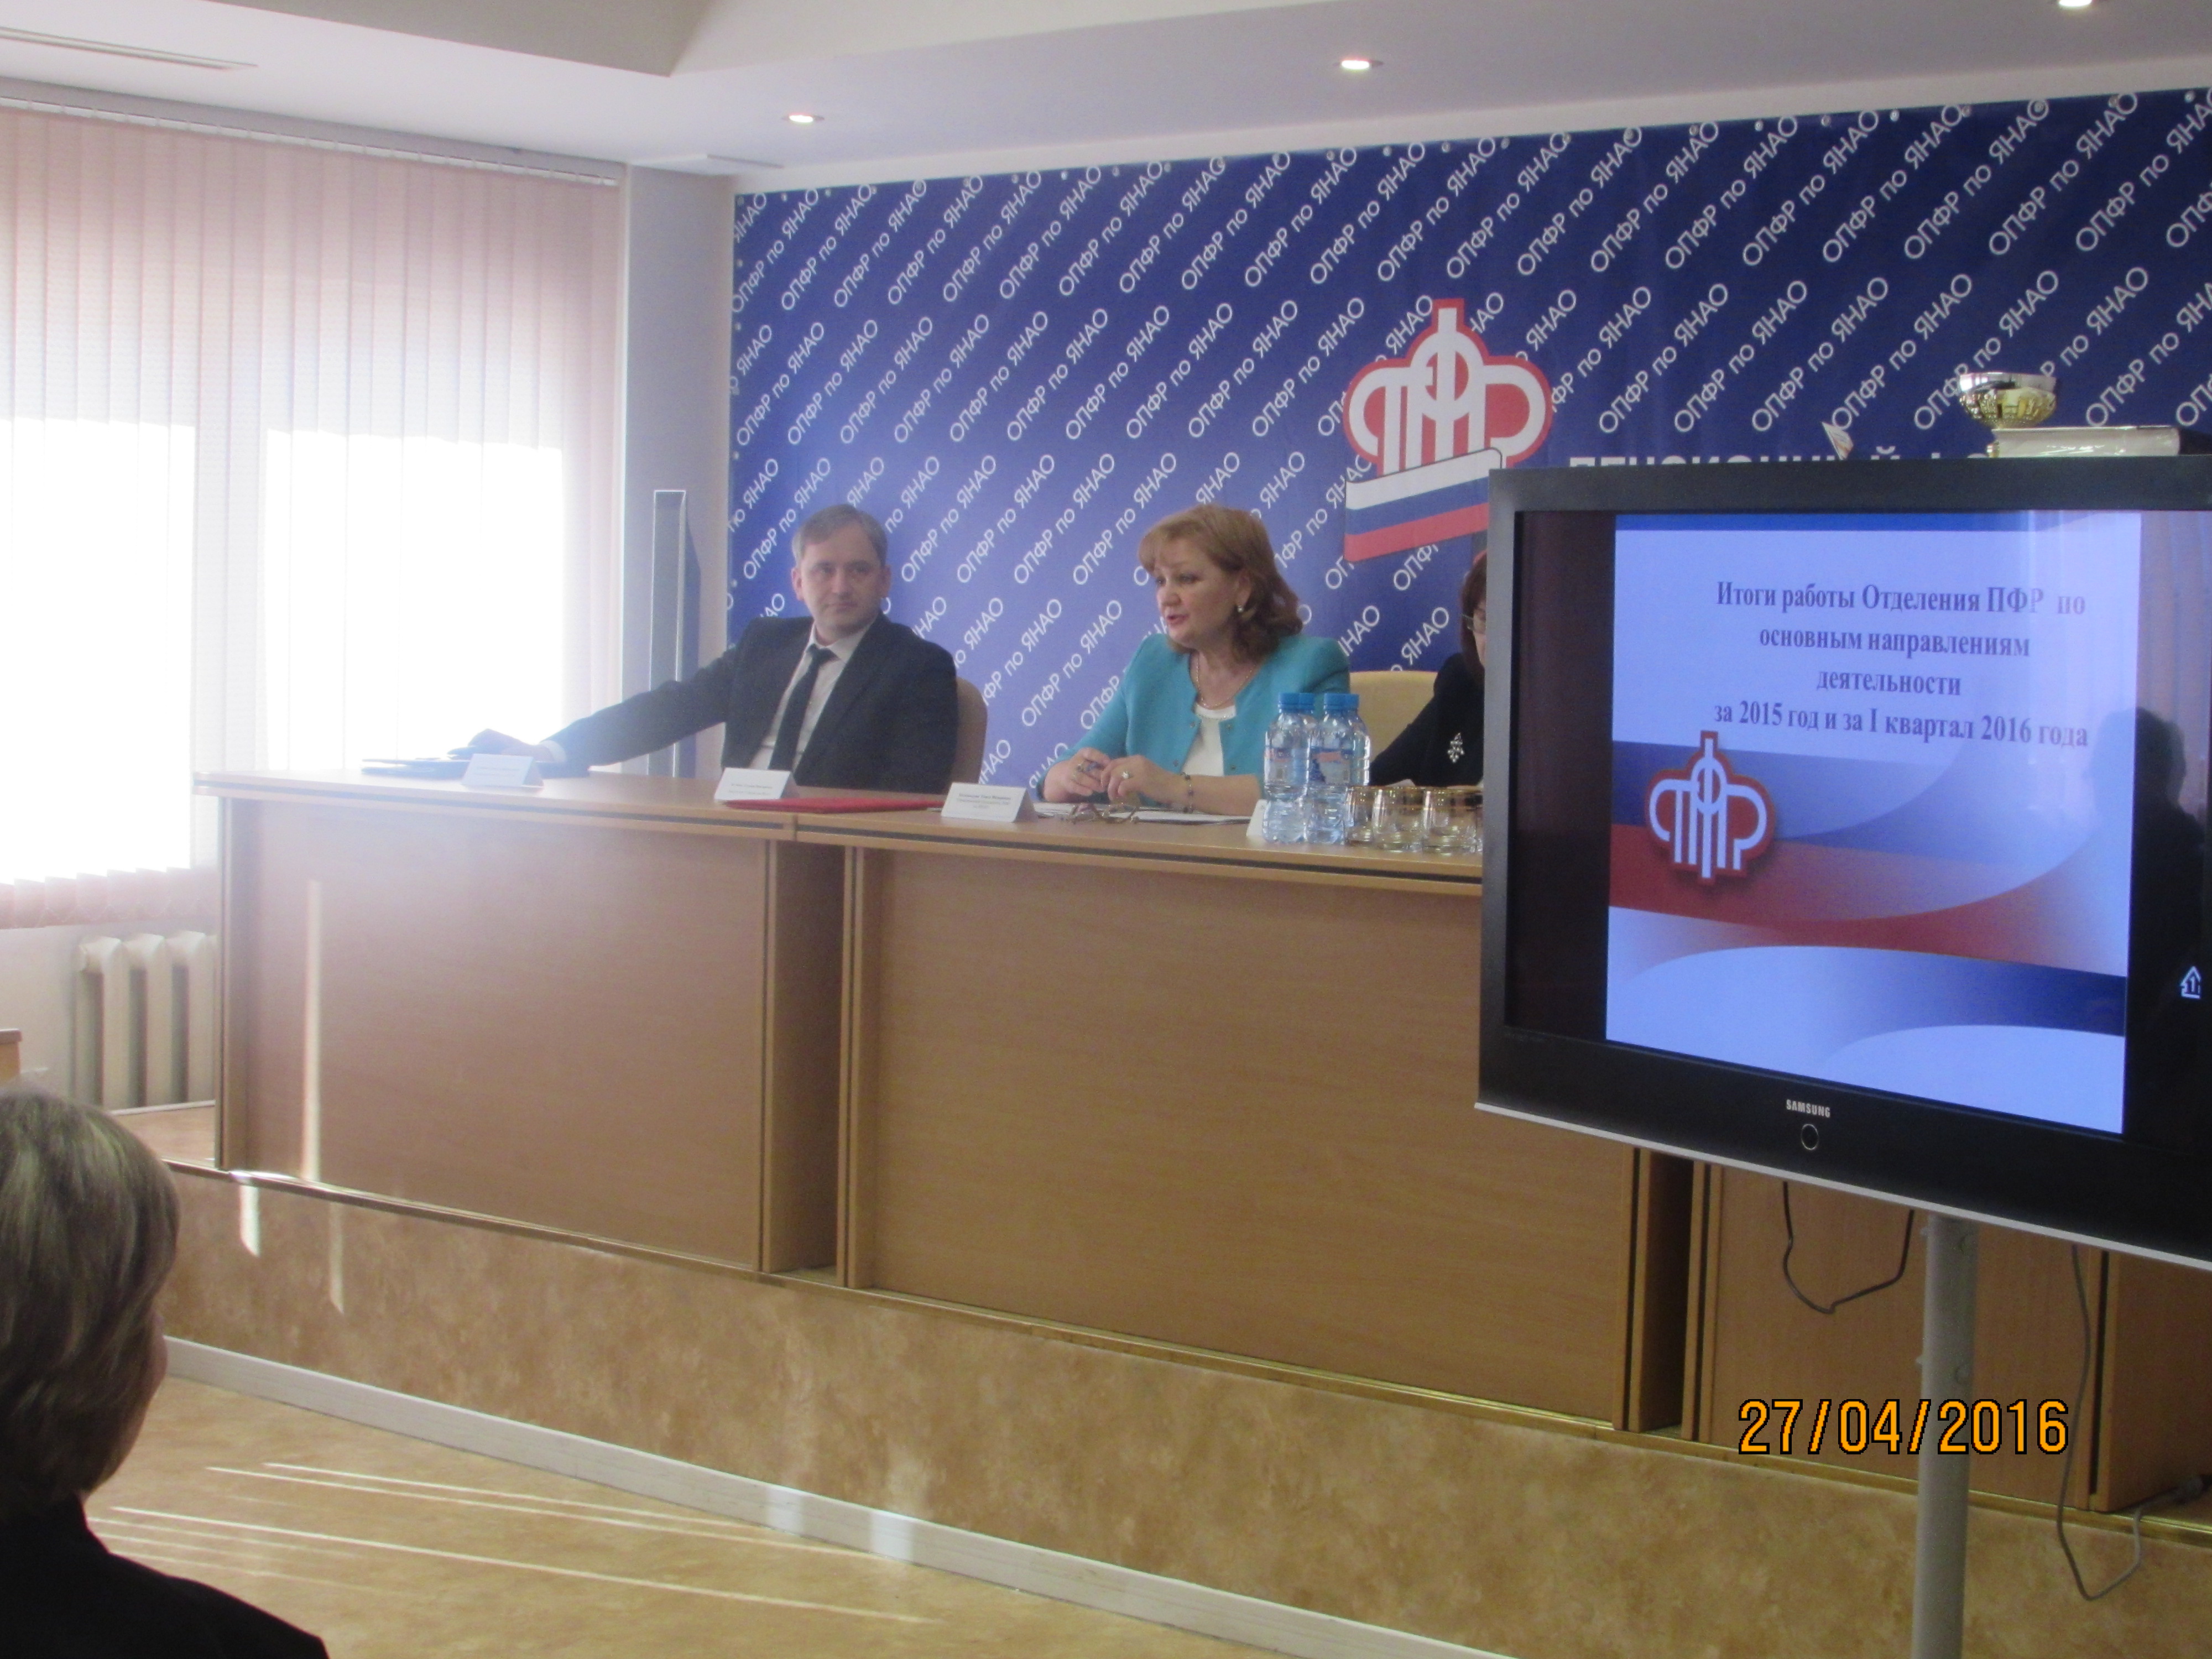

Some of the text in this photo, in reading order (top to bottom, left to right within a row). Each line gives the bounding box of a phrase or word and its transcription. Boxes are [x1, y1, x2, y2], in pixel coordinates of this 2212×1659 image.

[1059, 163, 1163, 295] ОПФР по ЯНАО
[1245, 148, 1357, 286] ОПФР по ЯНАО
[1310, 145, 1425, 284] ОПФР по ЯНАО
[1378, 140, 1495, 281] ОПФР по ЯНАО
[1447, 192, 1520, 278] ОПФР по
[1517, 188, 1593, 275] ОПФР по
[1591, 124, 1719, 272] ОПФР по ЯНАО
[1665, 180, 1746, 269] ОПФР по
[1743, 113, 1879, 265] ОПФР по ЯНАО
[1823, 106, 1962, 262] ОПФР по ЯНАО
[1905, 165, 1991, 259] ОПФР по
[1989, 95, 2138, 255] ОПФР по ЯНАО
[2076, 154, 2169, 251] ОПФР по
[731, 240, 784, 312] ОПФР по
[781, 185, 873, 310] ОПФР по ЯНАО
[834, 232, 890, 307] ОПФР по
[888, 177, 983, 304] ОПФР по ЯНАО
[943, 173, 1041, 301] ОПФР по ЯНАО
[1000, 221, 1061, 299] ОПФР по
[1119, 212, 1183, 293] ОПФР по
[1182, 208, 1248, 289] ОПФР по
[737, 325, 772, 375] ЯНАО
[950, 311, 1048, 442] ОПФР по ЯНАО
[1007, 308, 1108, 440] ОПФР по ЯНАО
[1066, 305, 1169, 439] ОПФР по ЯНАО
[1126, 302, 1233, 439] ОПФР по ЯНАО
[1188, 300, 1297, 437] ОПФР по ЯНАО
[1253, 298, 1364, 436] ОПФР по ЯНАО
[1526, 289, 1576, 351] ЯНАО
[1578, 286, 1651, 377] по ЯНАО
[1599, 283, 1728, 433] ОПФР по ЯНАО
[1674, 280, 1807, 432] ОПФР по ЯНАО
[1752, 277, 1888, 431] ОПФР по ЯНАО
[1889, 274, 1972, 370] по ЯНАО
[1974, 270, 2058, 367] по ЯНАО
[2060, 267, 2148, 366] по ЯНАО
[2150, 332, 2179, 364] по
[737, 322, 824, 445] ОПФР по ЯНАО
[788, 319, 878, 445] ОПФР по ЯНАО
[840, 316, 932, 444] ОПФР по ЯНАО
[894, 314, 989, 442] ОПФР по ЯНАО
[743, 458, 778, 509] ЯНАО
[744, 457, 831, 579] ОПФР по ЯНАО
[901, 456, 940, 509] ЯНАО
[901, 455, 996, 582] ОПФР по ЯНАО
[957, 454, 1055, 583] ОПФР по ЯНАО
[1014, 453, 1114, 583] ОПФР по ЯНАО
[1073, 453, 1176, 585] ОПФР по ЯНАО
[1260, 451, 1305, 509] ЯНАО
[1306, 509, 1327, 535] по
[964, 597, 1003, 650] ЯНАО
[1005, 599, 1062, 676] по ЯНАО
[1401, 607, 1449, 665] ЯНАО
[1717, 581, 2086, 615] Итоги работы Отделения ПФР по
[1759, 628, 2031, 659] основным направлениям
[1021, 600, 1121, 726] ОПФР по ЯНАО
[1714, 705, 1733, 723] за
[1739, 700, 1783, 726] 2015
[1788, 709, 1819, 730] год
[1824, 712, 1837, 730] и
[1844, 713, 1864, 732] за
[1885, 716, 1975, 743] квартал
[1981, 714, 2032, 743] 2016
[2039, 726, 2089, 747] года
[1815, 671, 1961, 696] деятельности
[1786, 1099, 1830, 1118] SAMSUNG
